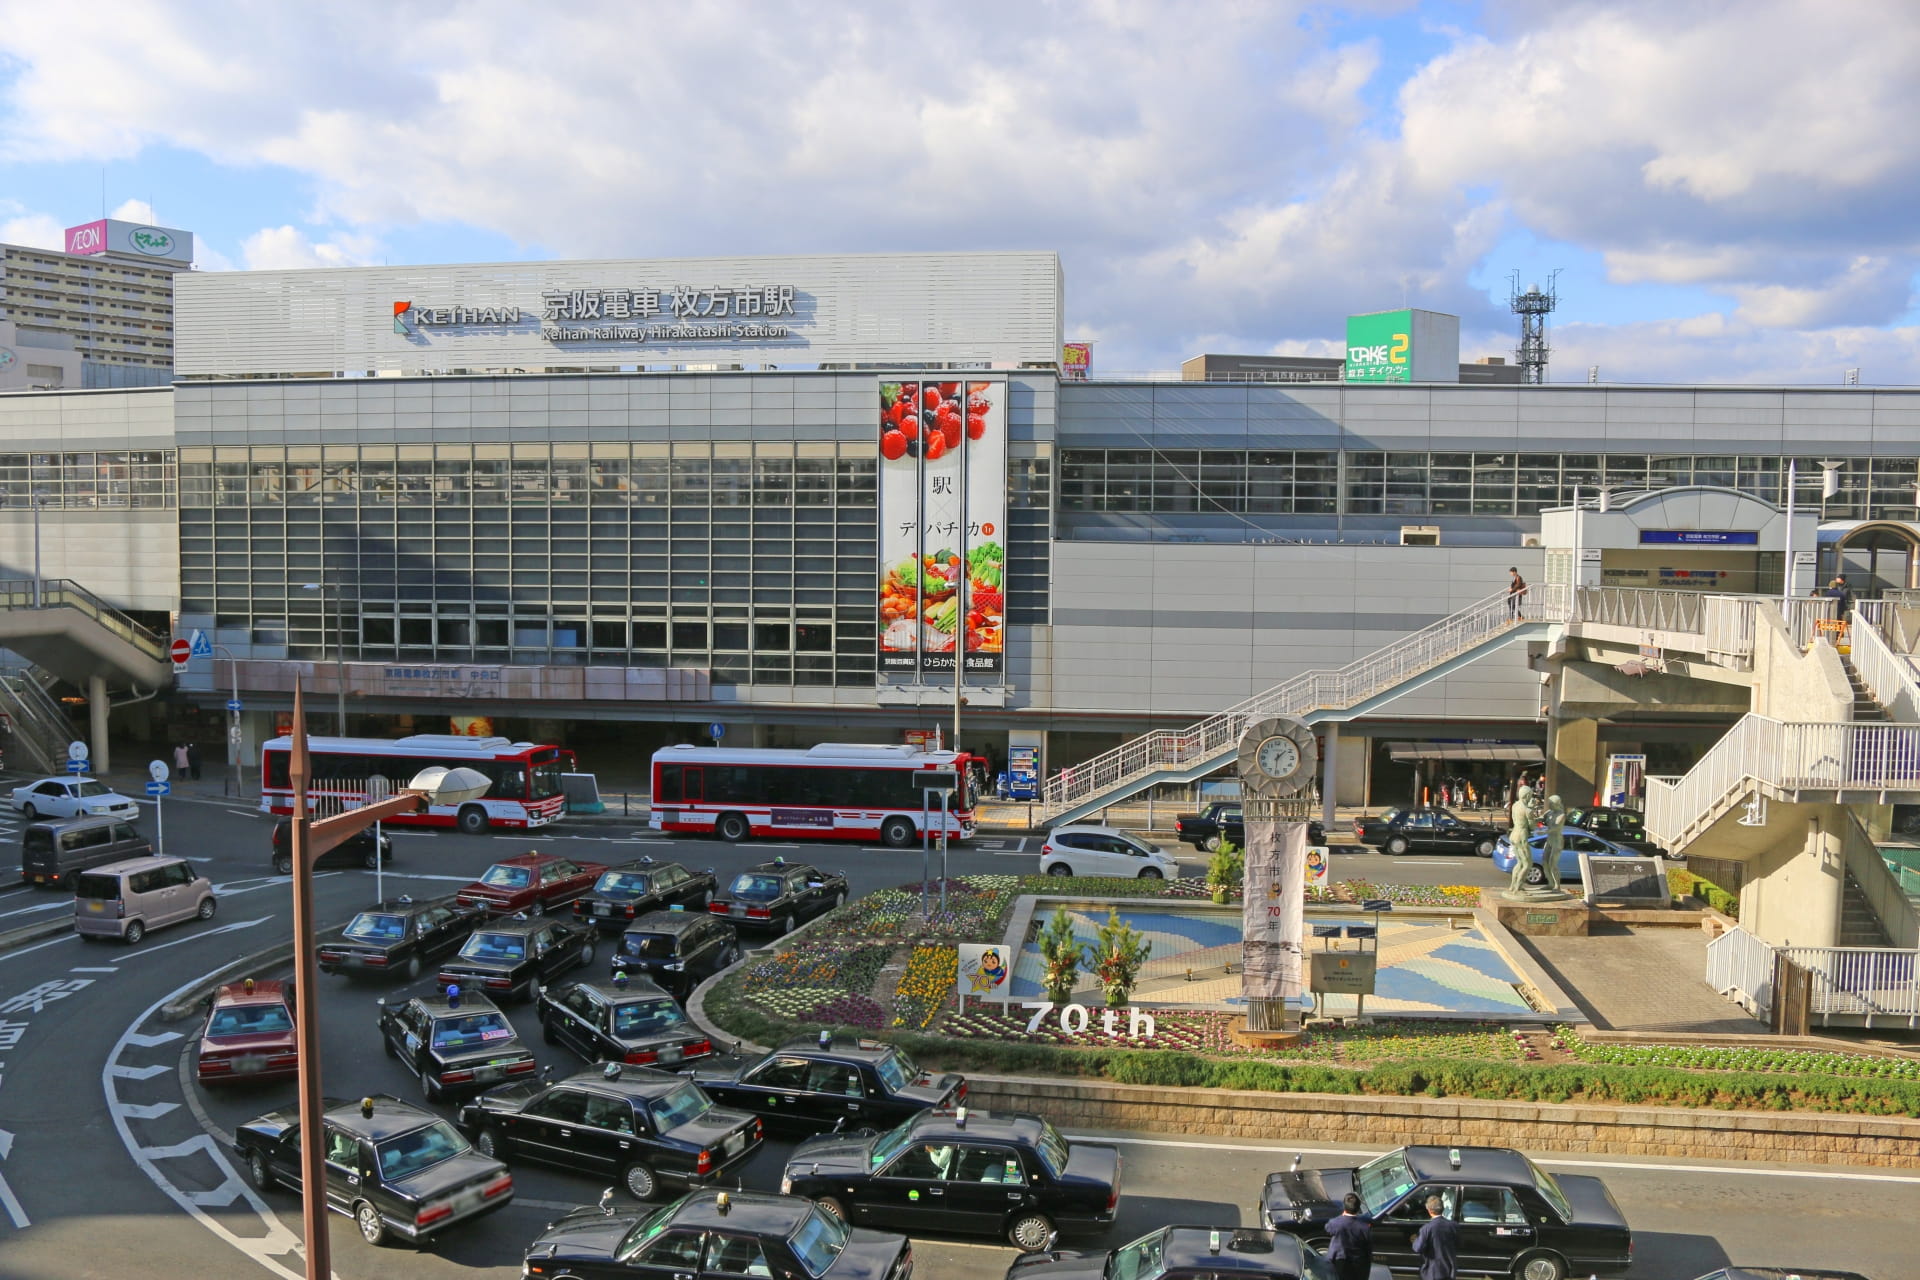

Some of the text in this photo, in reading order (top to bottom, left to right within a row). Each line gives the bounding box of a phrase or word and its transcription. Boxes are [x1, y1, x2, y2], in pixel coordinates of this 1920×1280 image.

[542, 285, 795, 320] 京阪電車 枚方市駅
[413, 305, 520, 325] KEIHAN
[541, 323, 788, 342] Keihan Railway Hirakatashi Station
[1348, 333, 1409, 366] TAKE 2
[1348, 368, 1365, 378] 枚方
[932, 476, 952, 495] 駅
[899, 521, 979, 537] デパチカ
[966, 658, 994, 668] 食品館
[471, 670, 499, 681] 中央口
[1269, 831, 1281, 878] 枚方市
[1021, 1001, 1155, 1040] 70th
